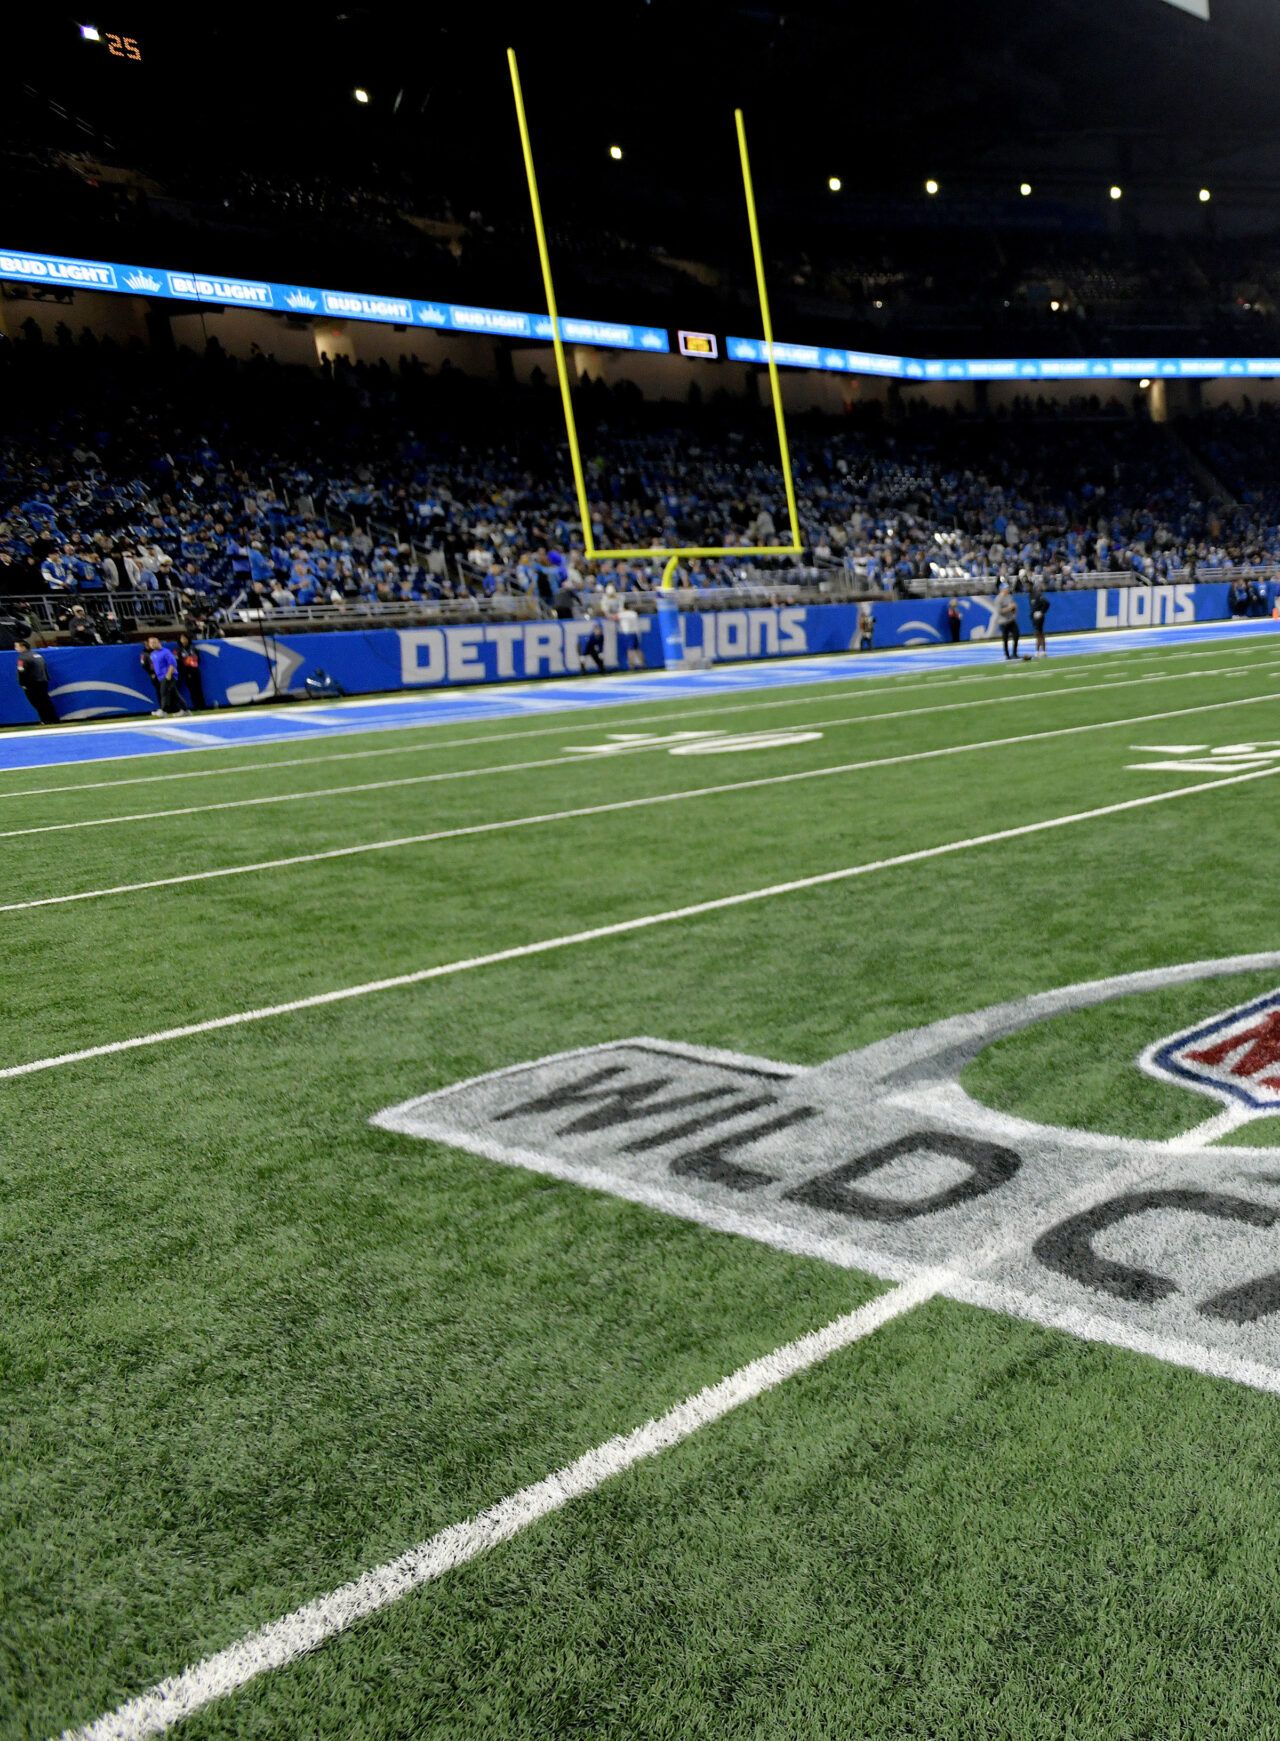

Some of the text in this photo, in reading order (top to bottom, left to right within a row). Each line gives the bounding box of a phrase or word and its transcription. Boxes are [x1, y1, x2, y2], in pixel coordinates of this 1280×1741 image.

[105, 32, 141, 60] 25
[0, 256, 111, 284] BUD LIGHT
[173, 279, 268, 302] BUD LIGHT
[326, 296, 408, 317] BUD LIGHT
[455, 310, 525, 330] BUD LIGHT
[1096, 584, 1195, 628] LIONS
[490, 1065, 1022, 1223] WILD
